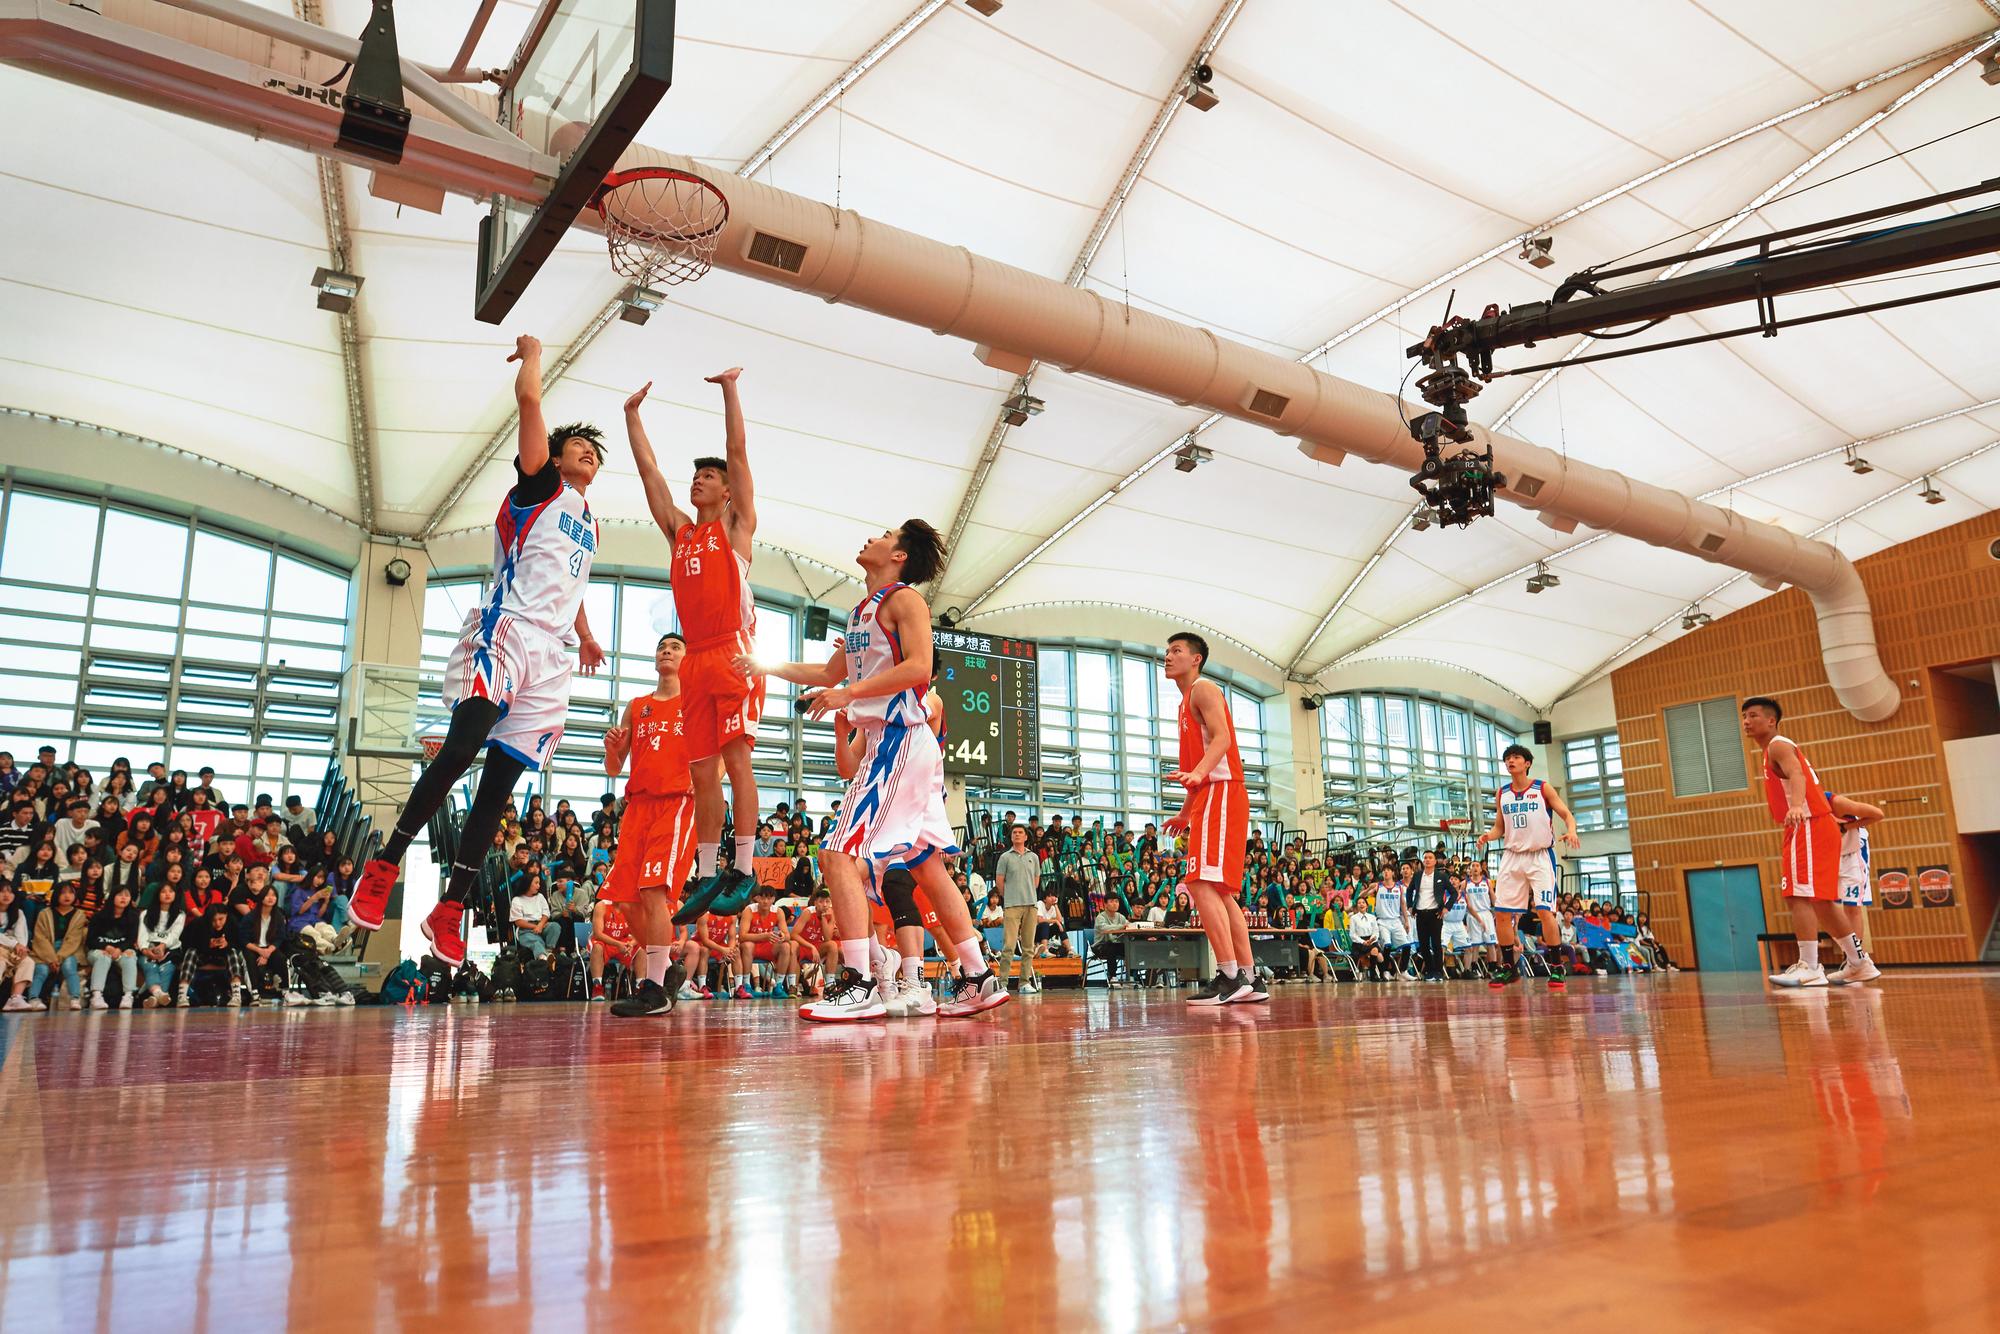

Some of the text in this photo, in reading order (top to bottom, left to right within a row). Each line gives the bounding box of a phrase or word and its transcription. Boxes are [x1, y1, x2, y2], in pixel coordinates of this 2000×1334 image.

[558, 511, 597, 556] 恆星高
[569, 548, 584, 578] 4
[685, 557, 701, 577] 19
[946, 667, 955, 680] 2
[962, 689, 991, 714] 36
[637, 720, 684, 738] 莊敬工家
[724, 713, 740, 734] 19
[989, 722, 999, 737] 5
[1513, 814, 1528, 829] 10
[644, 861, 662, 878] 14
[1541, 890, 1552, 903] 10
[1846, 885, 1860, 898] 14
[925, 911, 937, 924] 13
